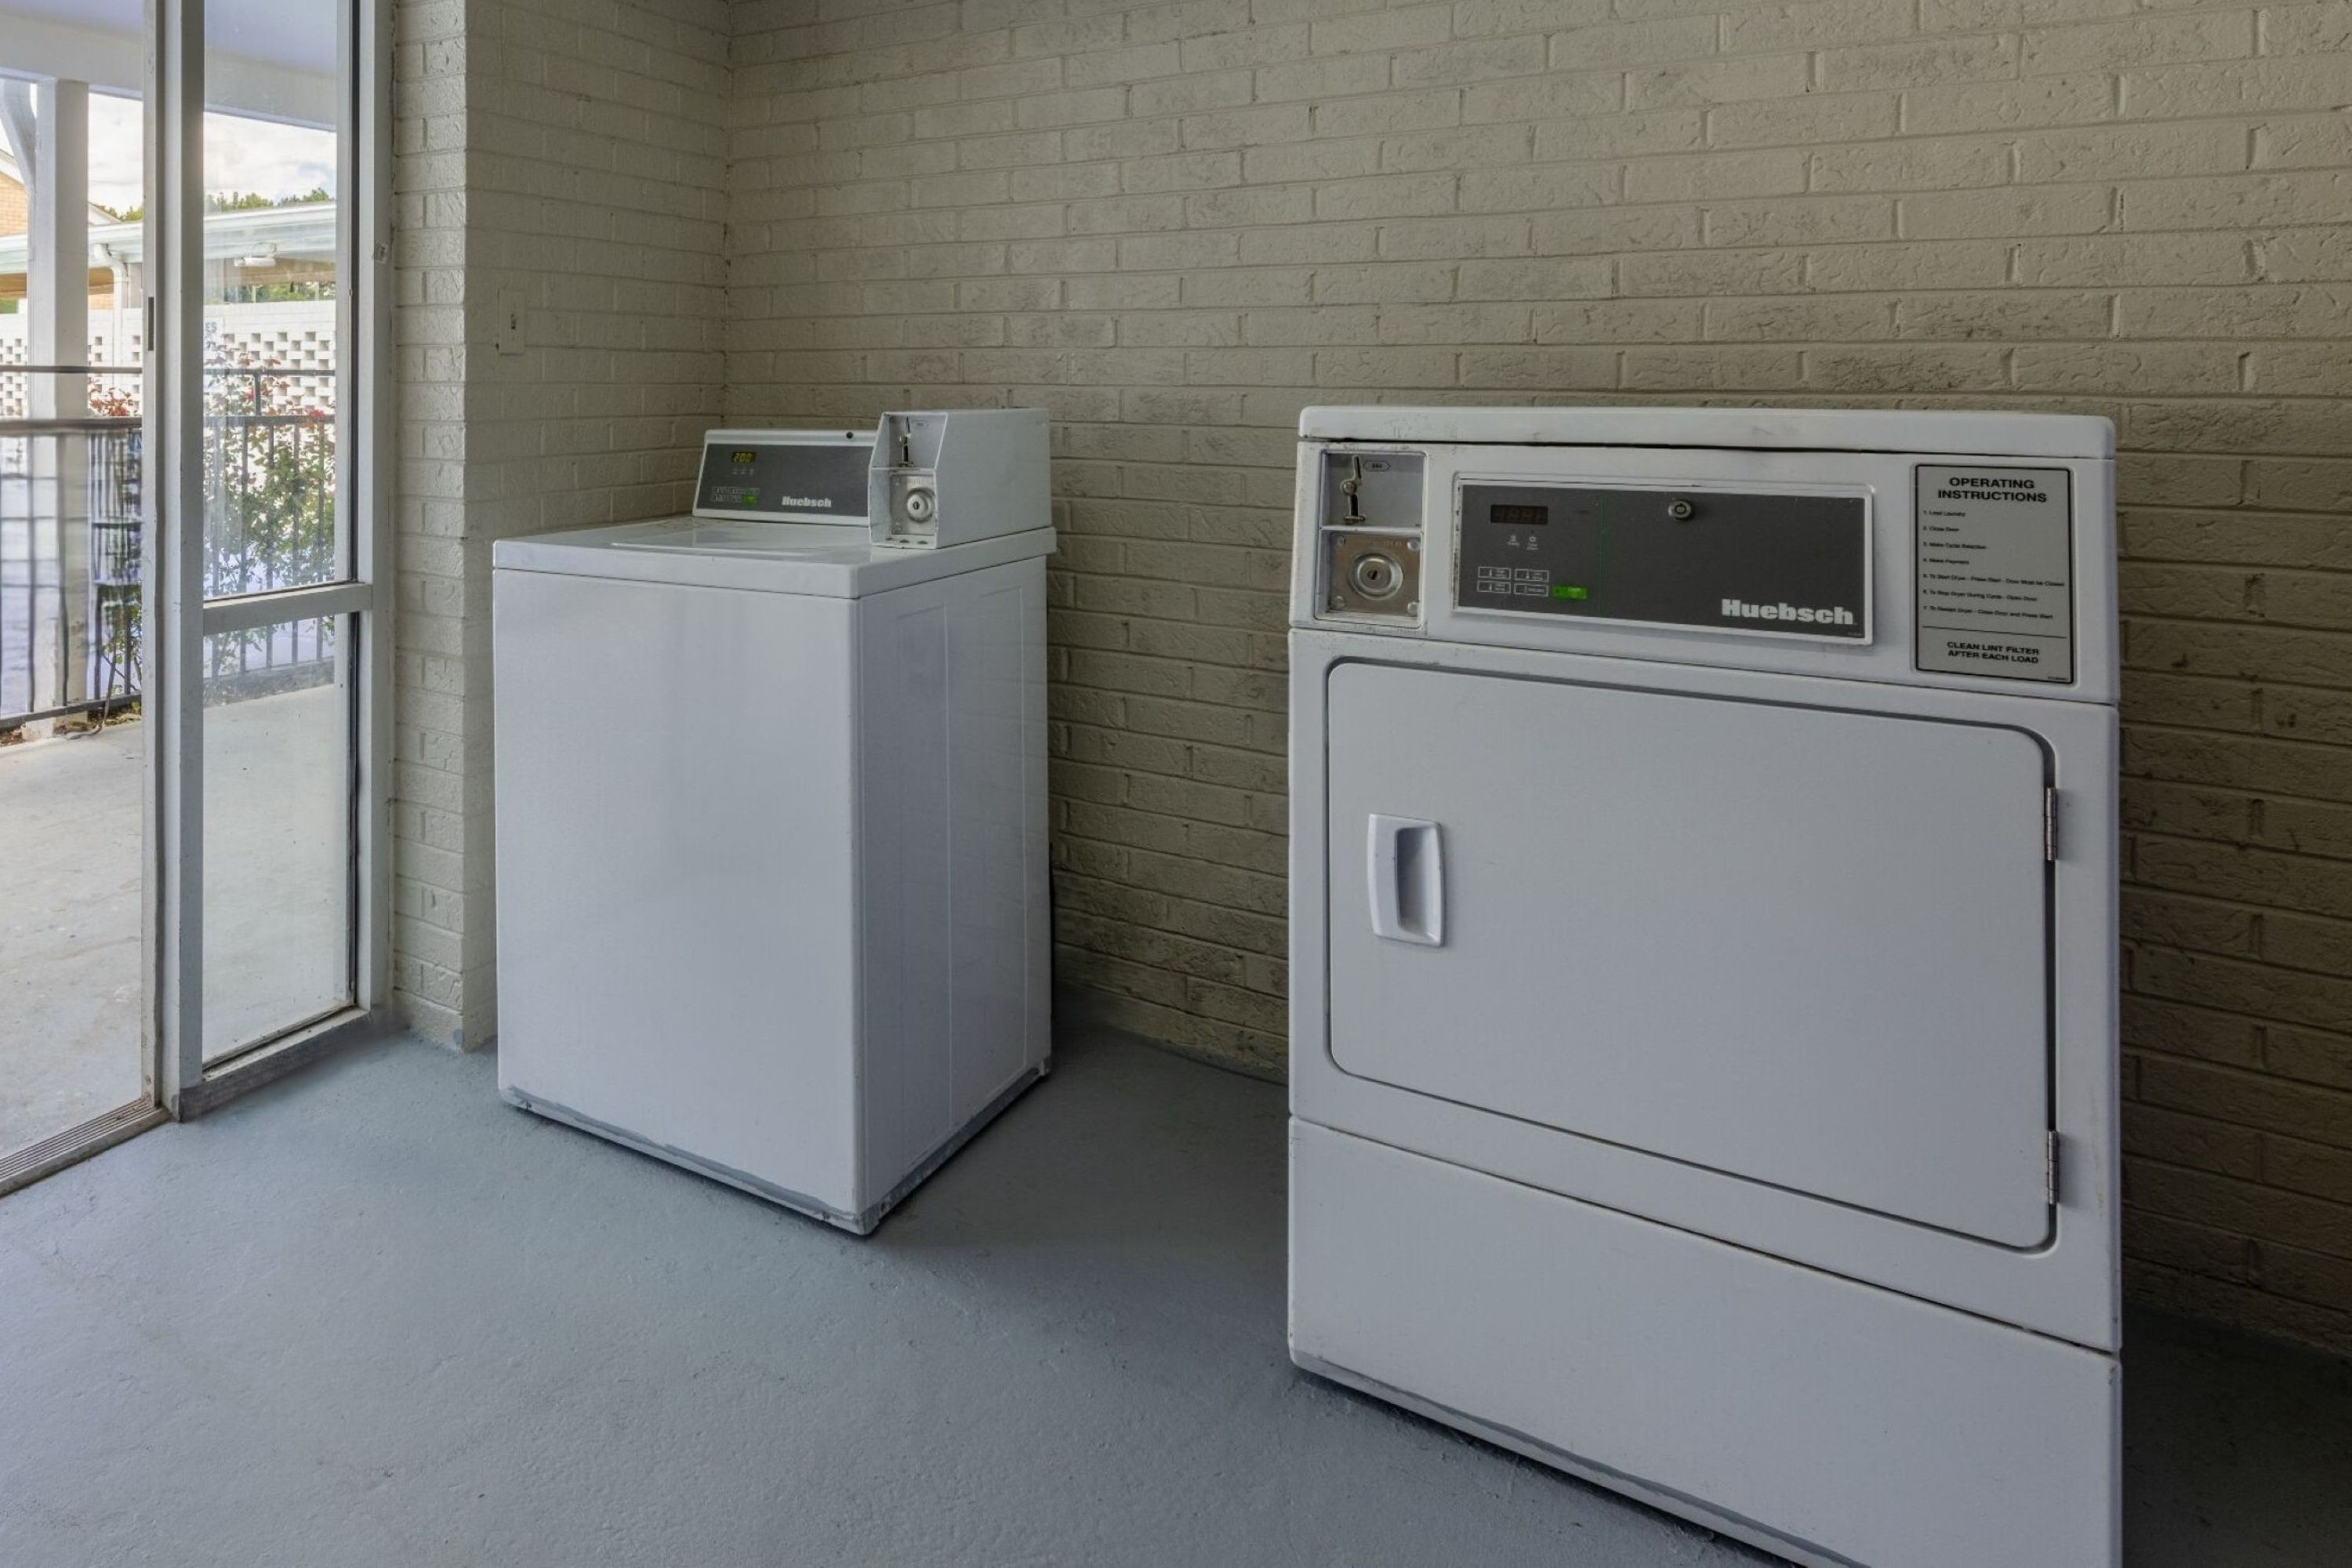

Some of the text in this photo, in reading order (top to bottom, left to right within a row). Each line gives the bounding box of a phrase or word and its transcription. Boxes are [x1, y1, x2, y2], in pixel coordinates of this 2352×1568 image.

[1949, 477, 2035, 489] OPERATING
[781, 495, 832, 508] Huebsch
[1937, 489, 2048, 503] INSTRUCTIONS
[1721, 598, 1854, 625] Huebsch
[1947, 641, 2039, 655] CLEAN LINT FILTER
[1947, 649, 2039, 664] AFTER EACH LOAD
